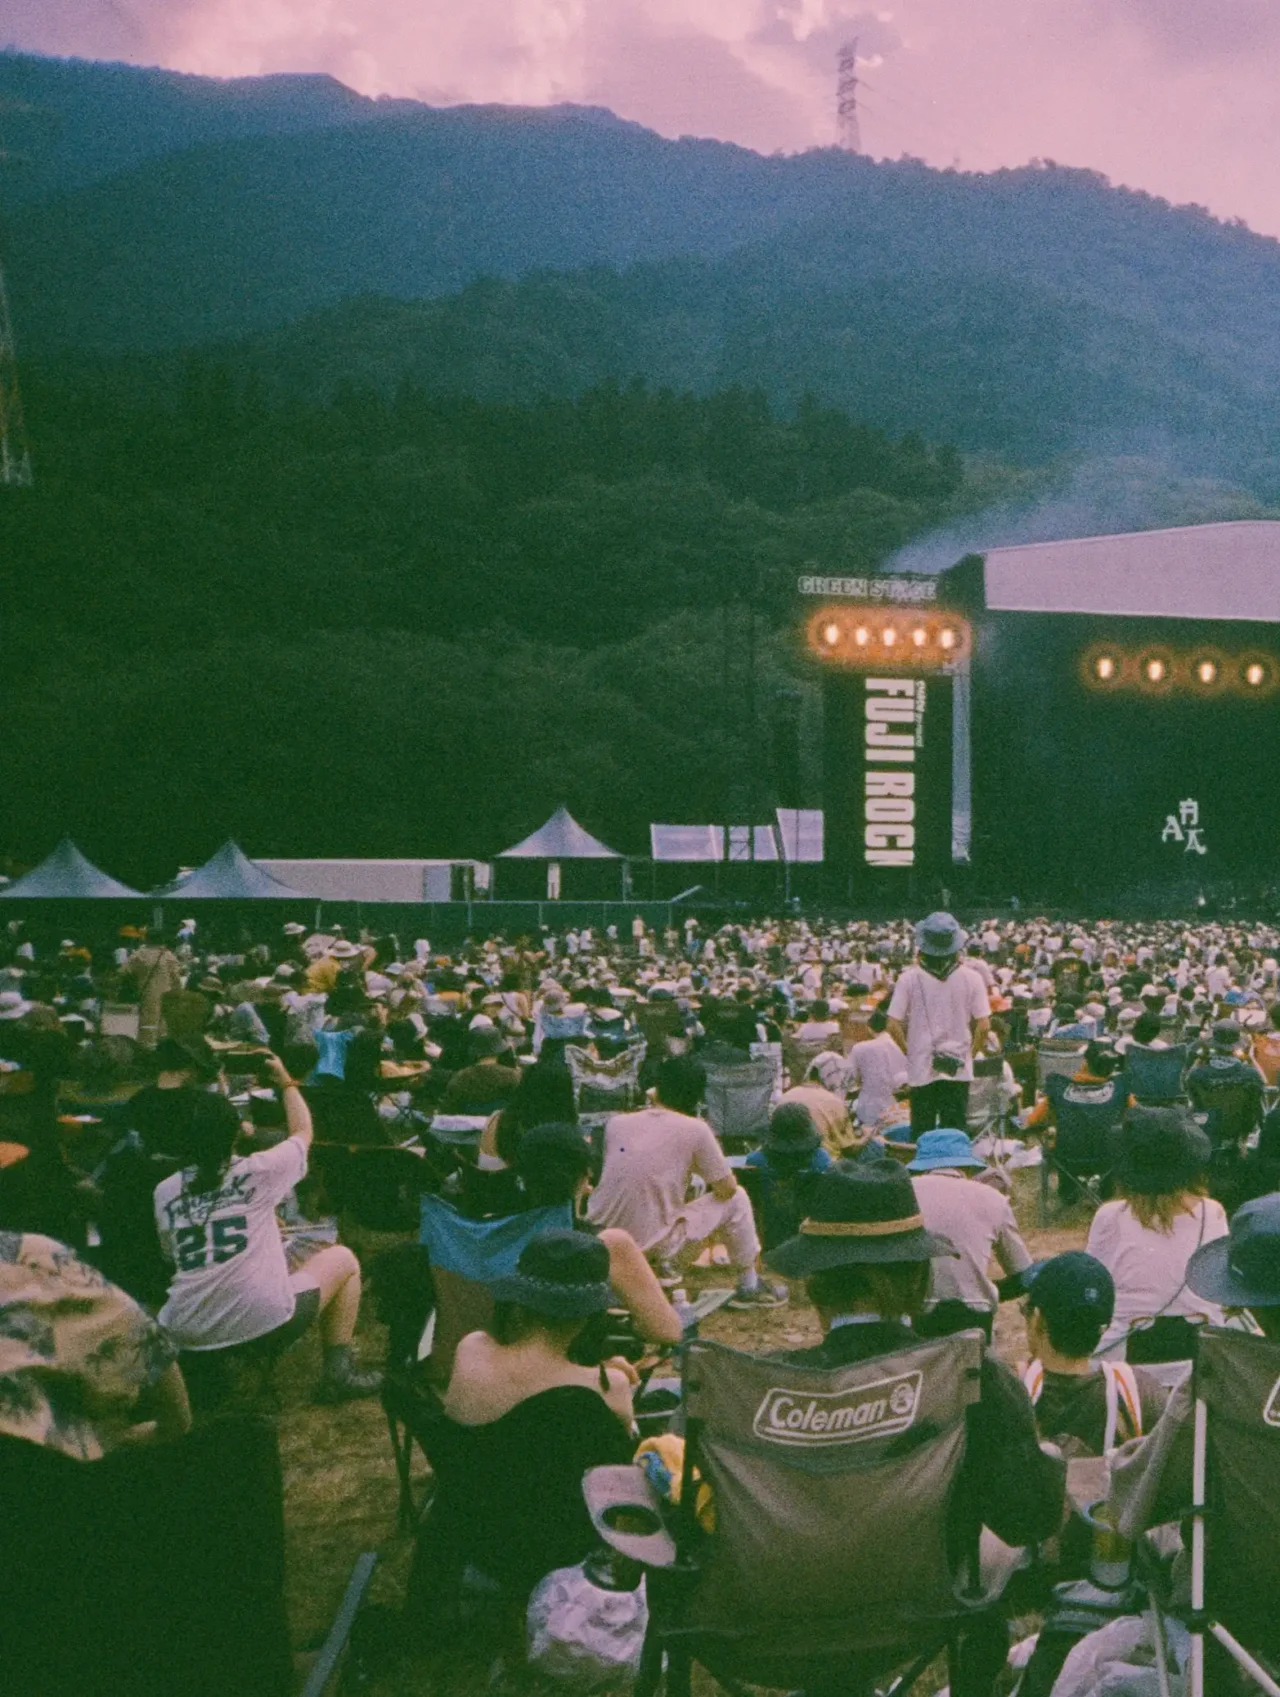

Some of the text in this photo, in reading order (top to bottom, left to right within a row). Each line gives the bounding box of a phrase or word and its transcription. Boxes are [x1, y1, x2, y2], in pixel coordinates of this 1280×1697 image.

[798, 576, 937, 599] GREEN STAGE
[865, 678, 915, 867] FUJI ROCK
[176, 1215, 248, 1271] 25
[769, 1396, 888, 1432] Coleman
